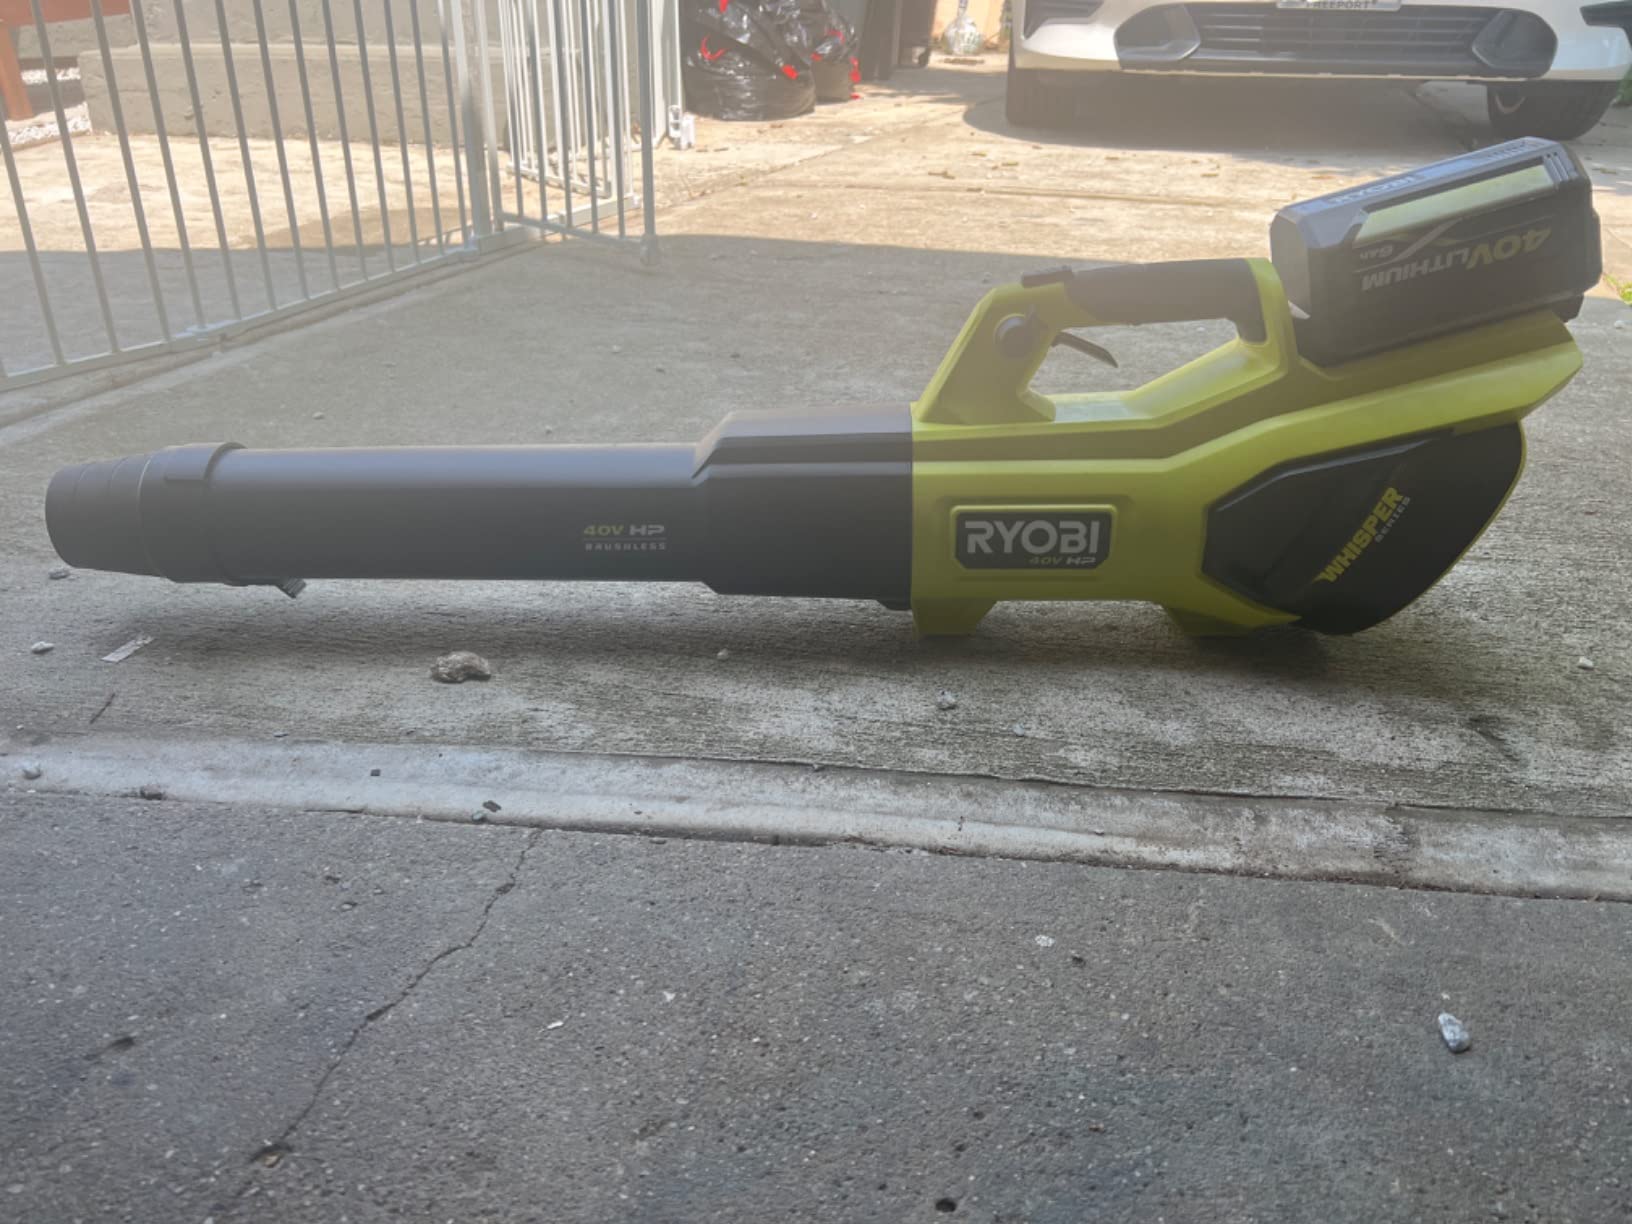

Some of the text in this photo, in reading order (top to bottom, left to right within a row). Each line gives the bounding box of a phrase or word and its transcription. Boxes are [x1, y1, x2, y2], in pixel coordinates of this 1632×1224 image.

[583, 524, 665, 535] 40V HP
[1312, 487, 1404, 583] WHISPER
[965, 519, 1100, 554] RYOBI
[584, 542, 666, 551] BRUSHLESS
[1028, 556, 1097, 565] 40V HP
